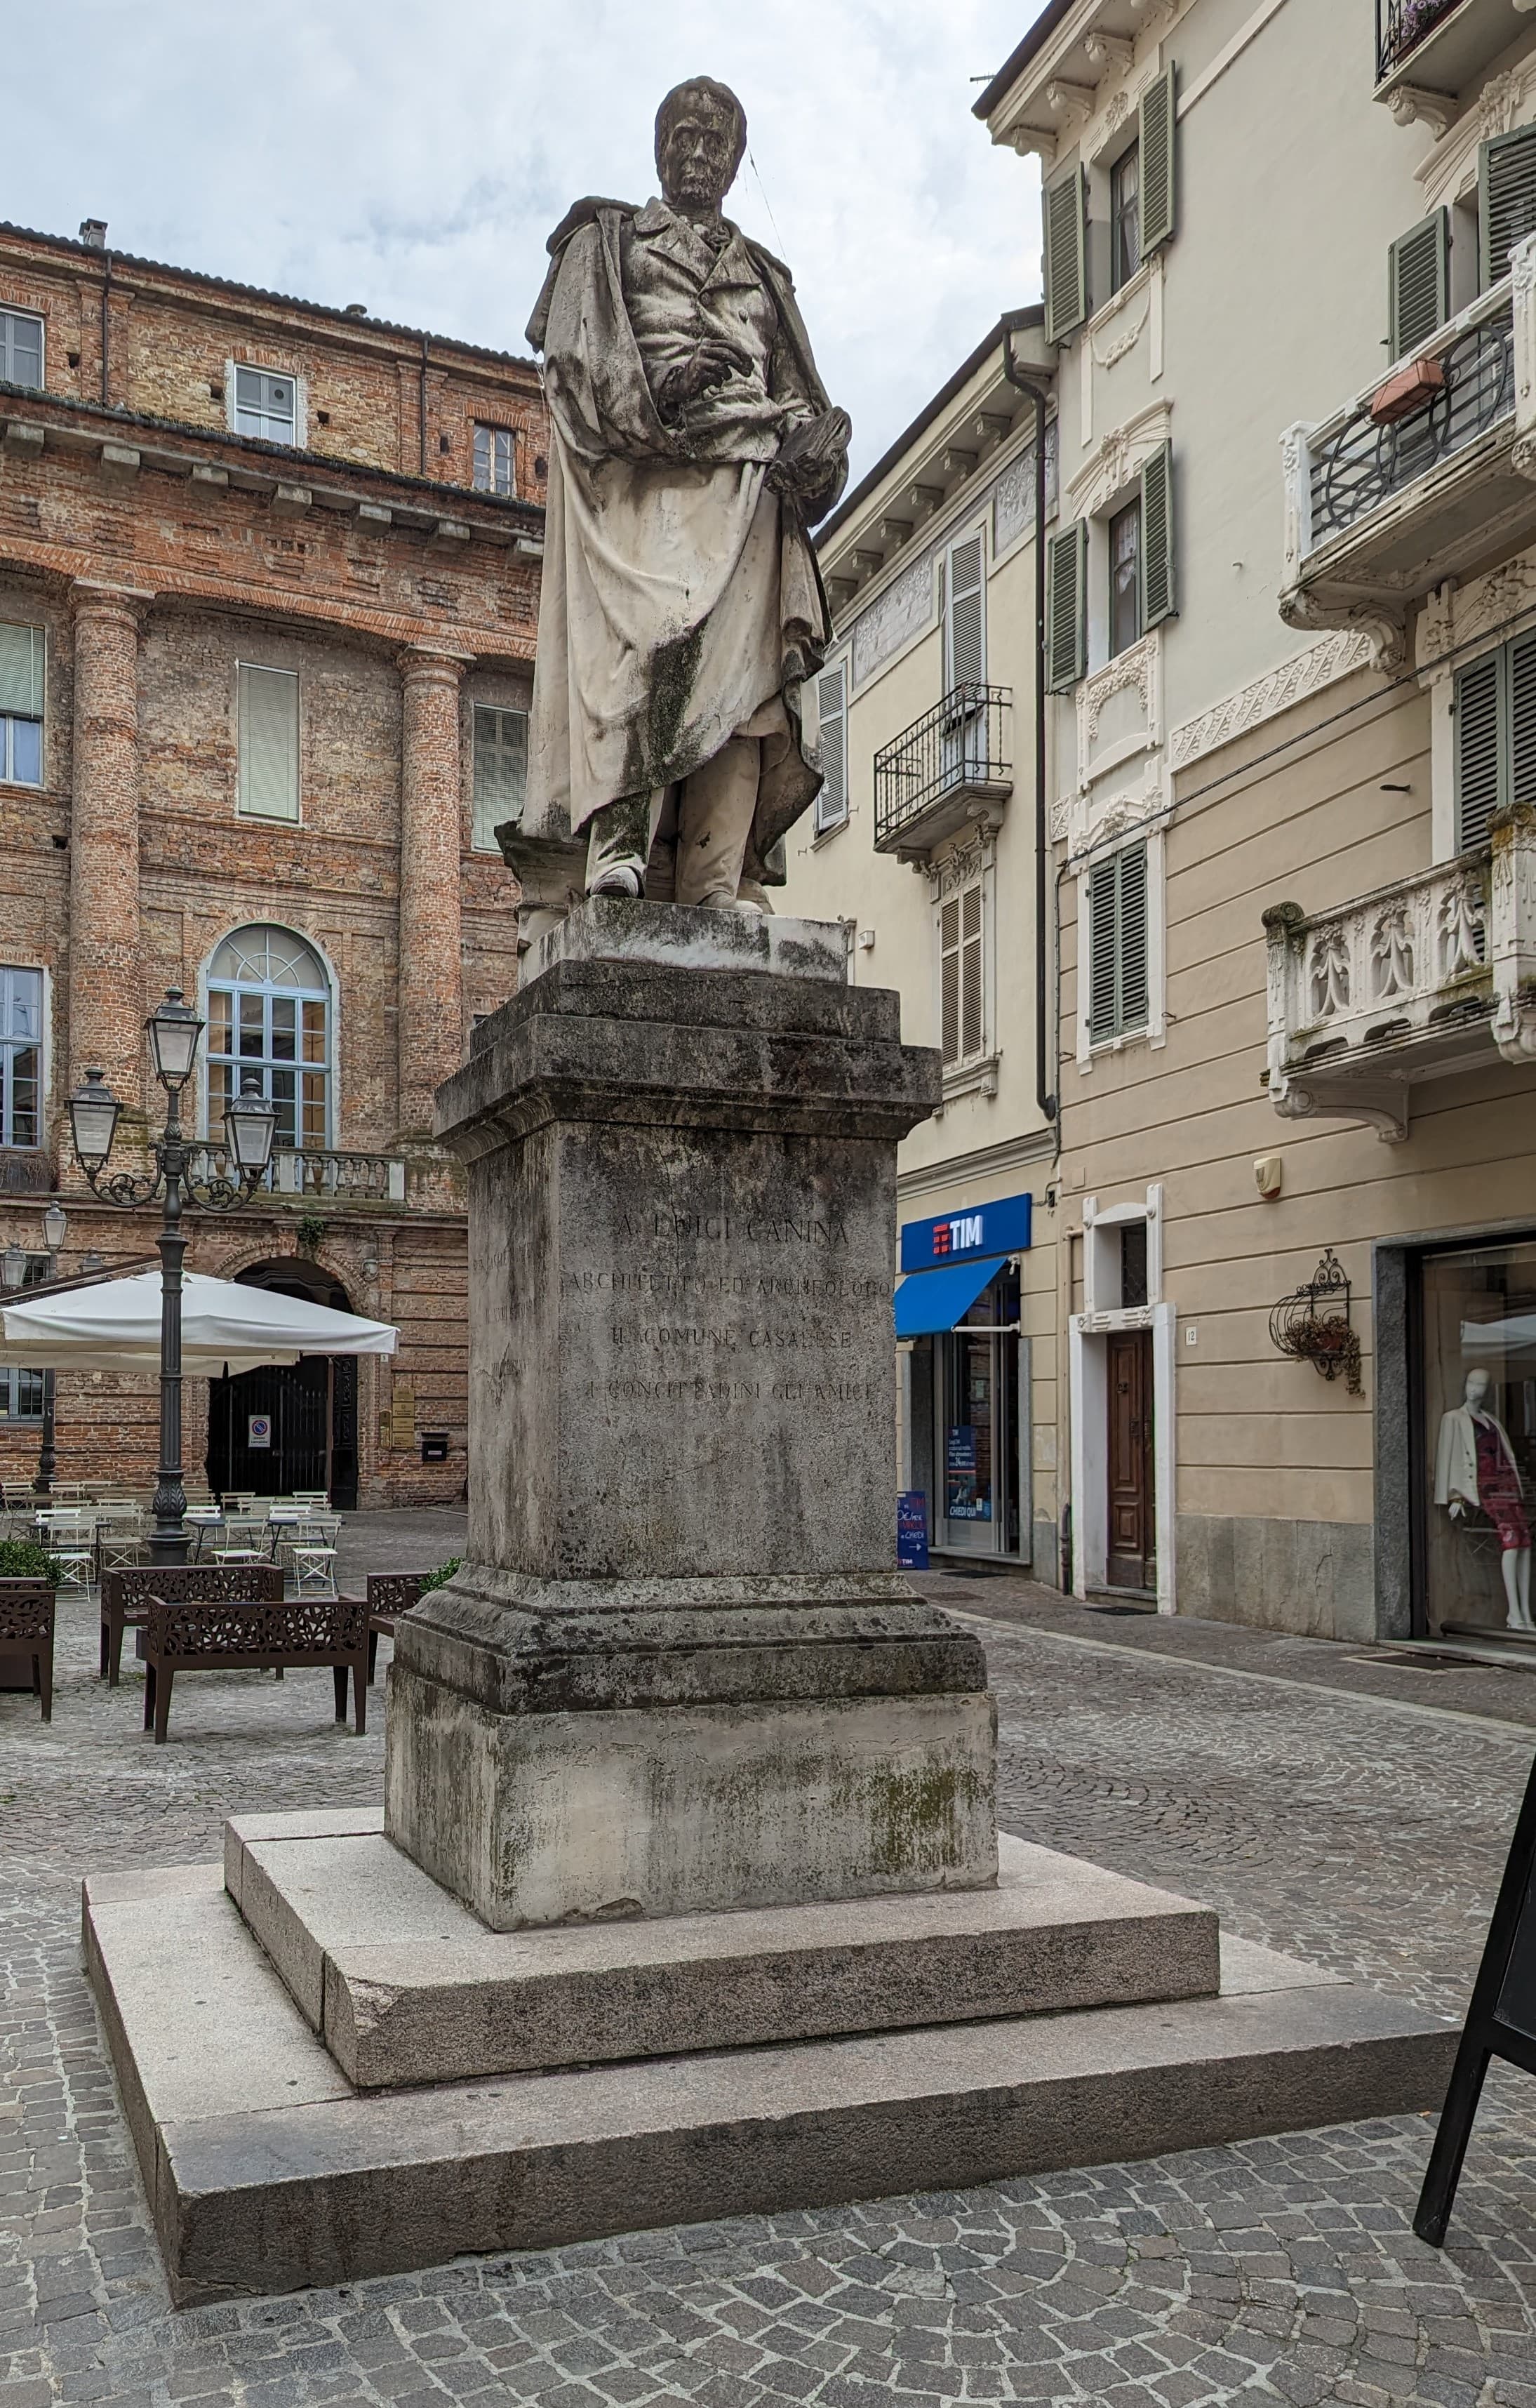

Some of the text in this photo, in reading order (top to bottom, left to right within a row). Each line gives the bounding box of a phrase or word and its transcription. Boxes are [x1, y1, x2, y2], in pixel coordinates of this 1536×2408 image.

[617, 1213, 849, 1245] A LUIGI CANINA
[949, 1214, 983, 1251] TIM
[568, 1272, 706, 1296] ARCHITETTO
[719, 1277, 744, 1294] ED
[643, 1326, 736, 1346] COMUNE
[749, 1331, 852, 1348] CASALESE
[1188, 1330, 1195, 1341] 12
[608, 1380, 759, 1400] CONCITTADINI
[772, 1383, 802, 1400] GLI
[814, 1383, 874, 1401] AMICI
[949, 1506, 976, 1517] CHIEDI QUI
